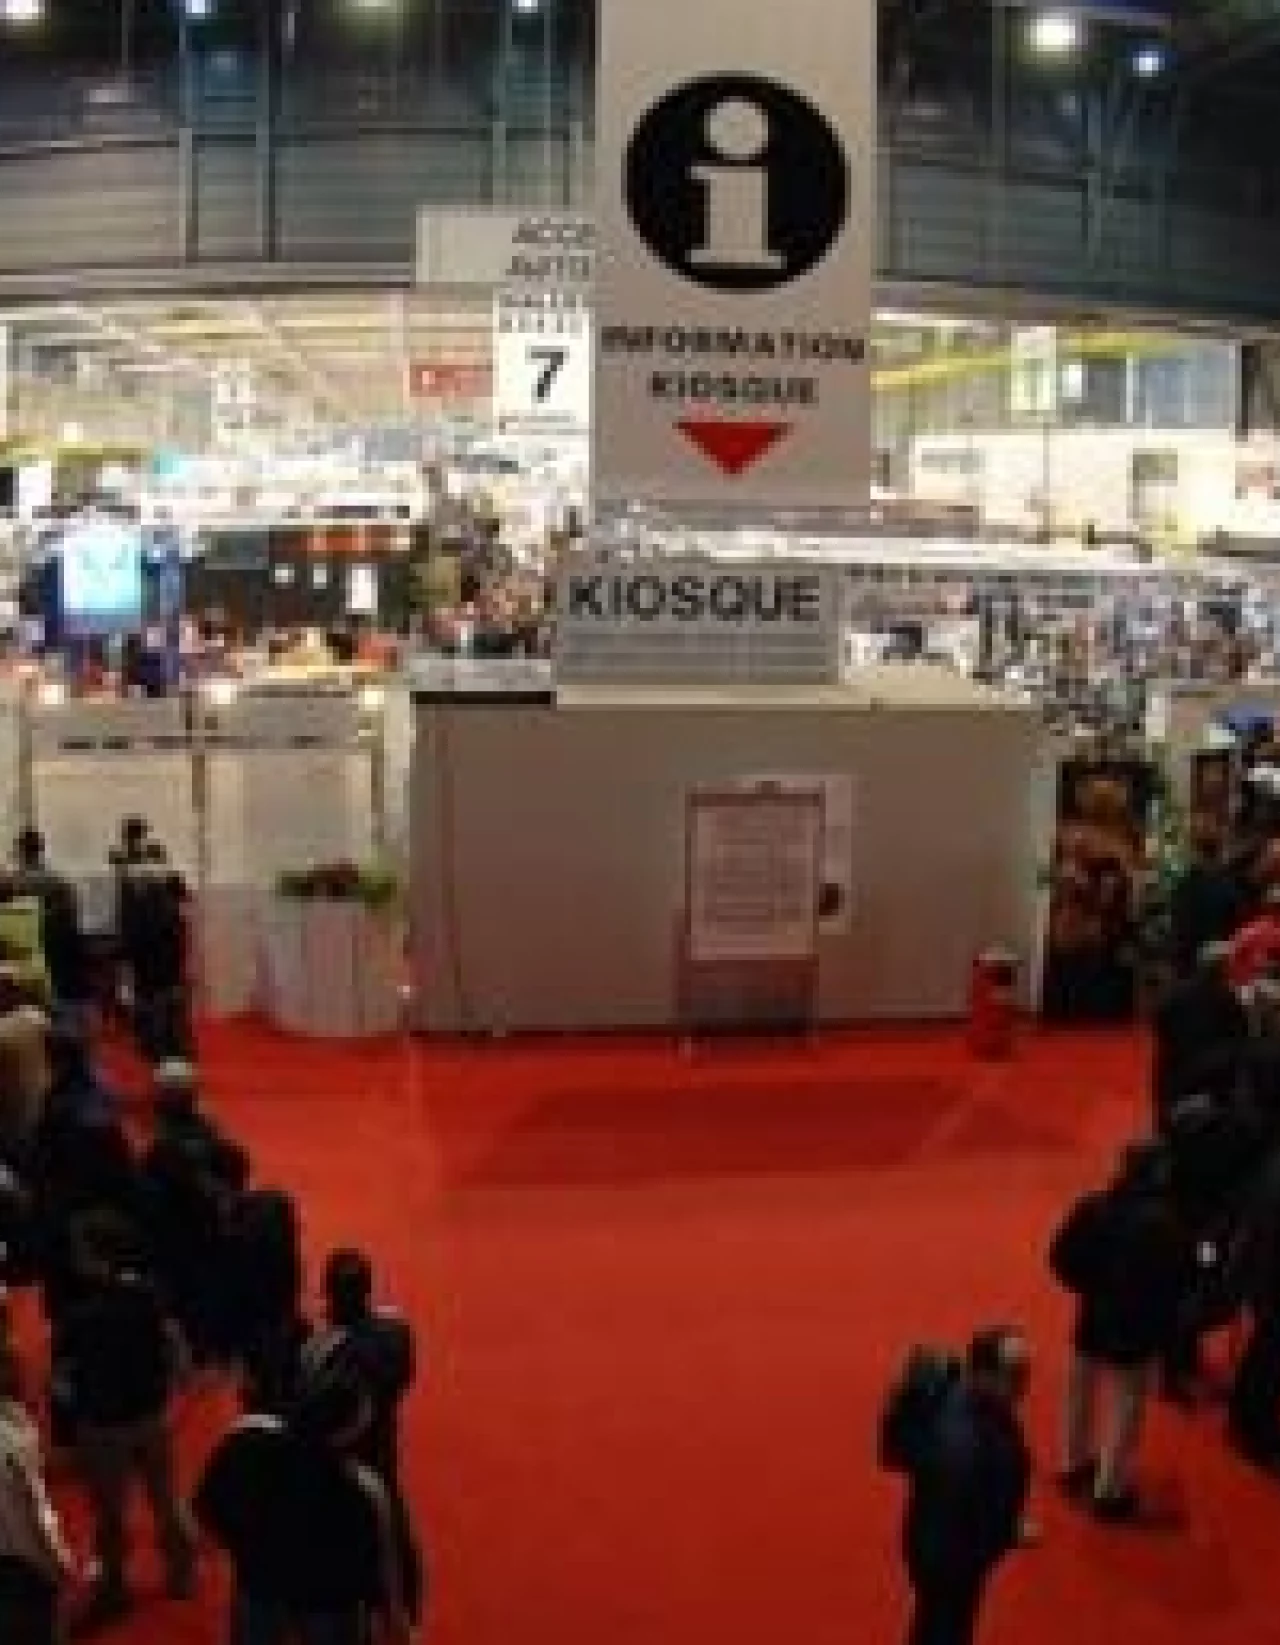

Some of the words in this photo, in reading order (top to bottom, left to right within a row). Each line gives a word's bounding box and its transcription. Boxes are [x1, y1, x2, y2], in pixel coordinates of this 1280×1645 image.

[601, 325, 866, 362] INFORMATION
[526, 346, 570, 403] 7
[649, 371, 819, 404] KIOSQUE
[568, 575, 820, 622] KIOSQUE
